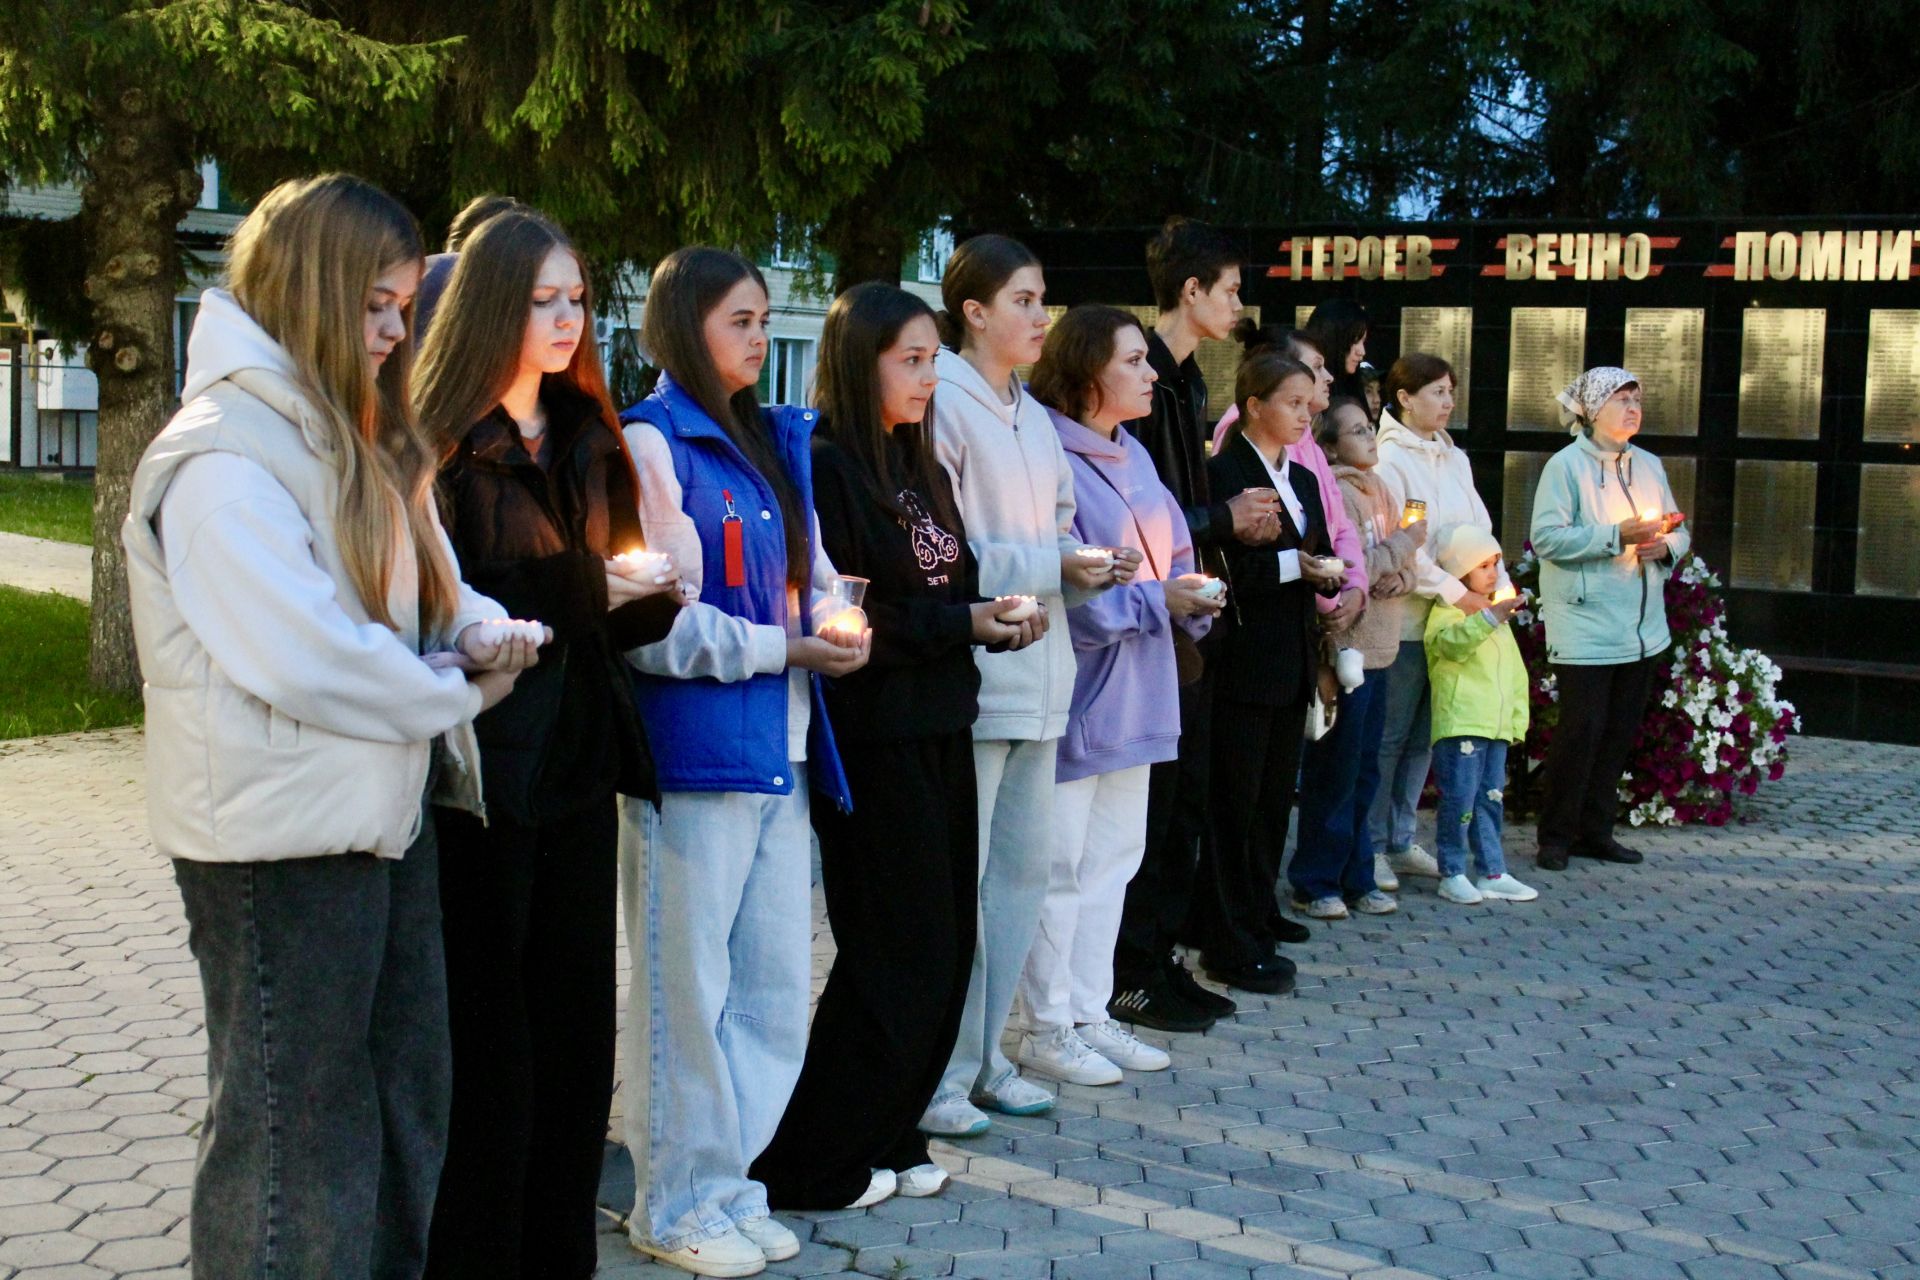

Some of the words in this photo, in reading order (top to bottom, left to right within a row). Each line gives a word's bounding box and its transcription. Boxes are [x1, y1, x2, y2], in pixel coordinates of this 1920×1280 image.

[1290, 235, 1432, 281] ГЕРОЕВ
[1505, 232, 1651, 281] ВЕЧНО
[1734, 230, 1920, 281] ПОМНИ
